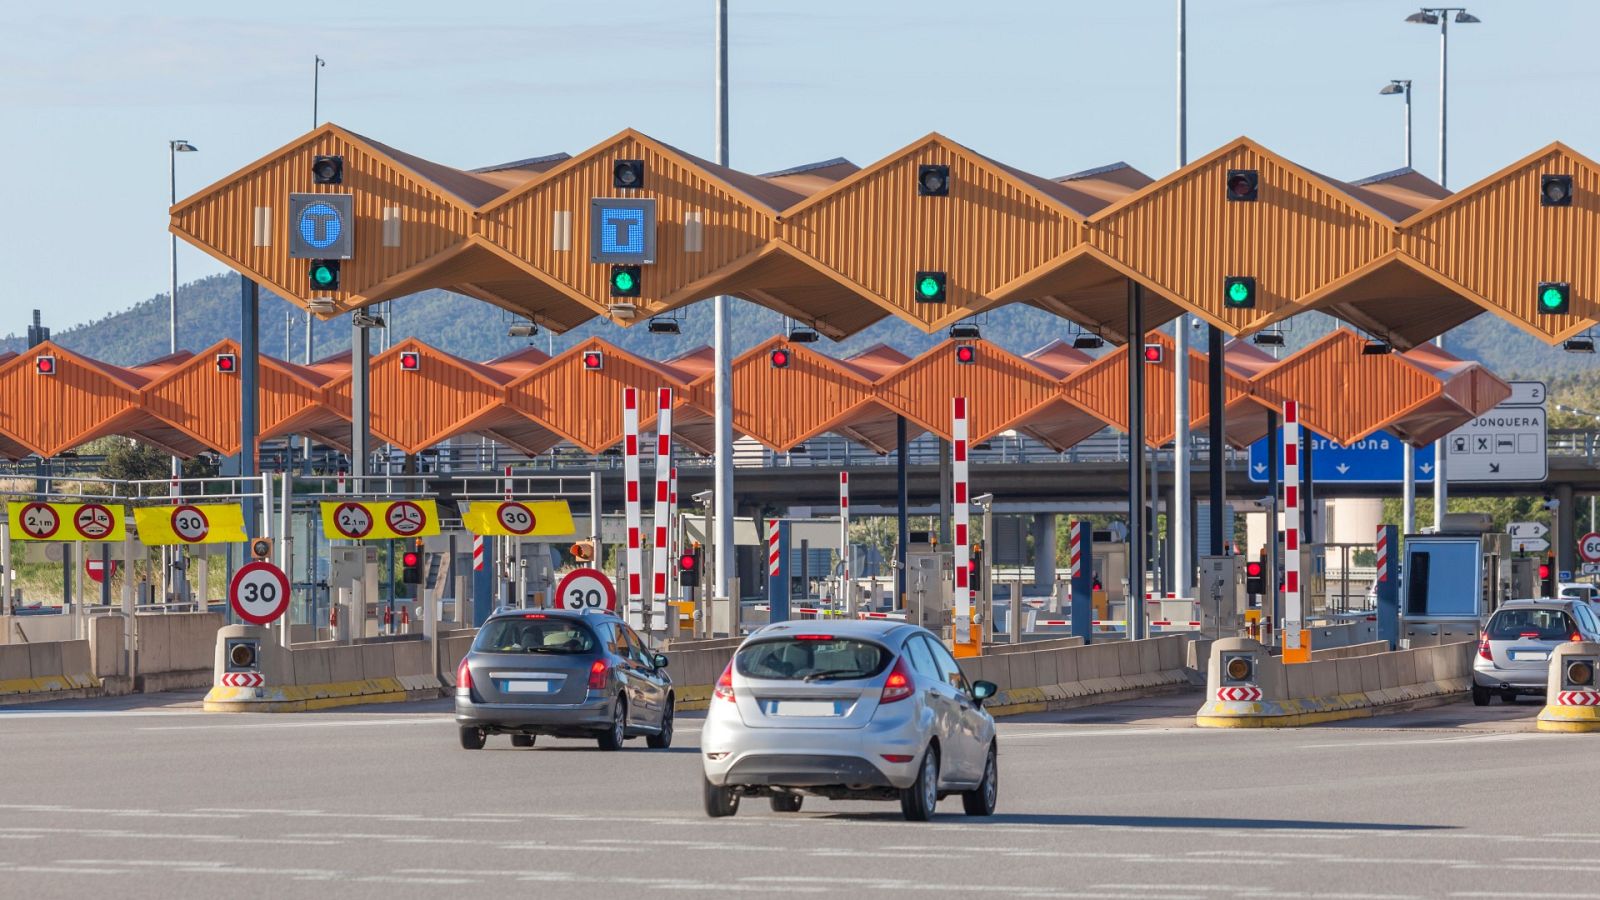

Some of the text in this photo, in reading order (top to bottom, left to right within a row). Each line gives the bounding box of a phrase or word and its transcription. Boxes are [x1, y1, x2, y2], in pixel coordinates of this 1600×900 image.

[305, 214, 335, 241] T
[607, 218, 637, 246] T
[1531, 388, 1540, 398] 2
[1471, 417, 1539, 427] JONQUERA
[1299, 436, 1390, 450] arcona
[179, 517, 202, 530] 30
[504, 512, 528, 524] 30
[1533, 526, 1541, 534] 2
[244, 582, 276, 602] 30
[569, 589, 602, 609] 30
